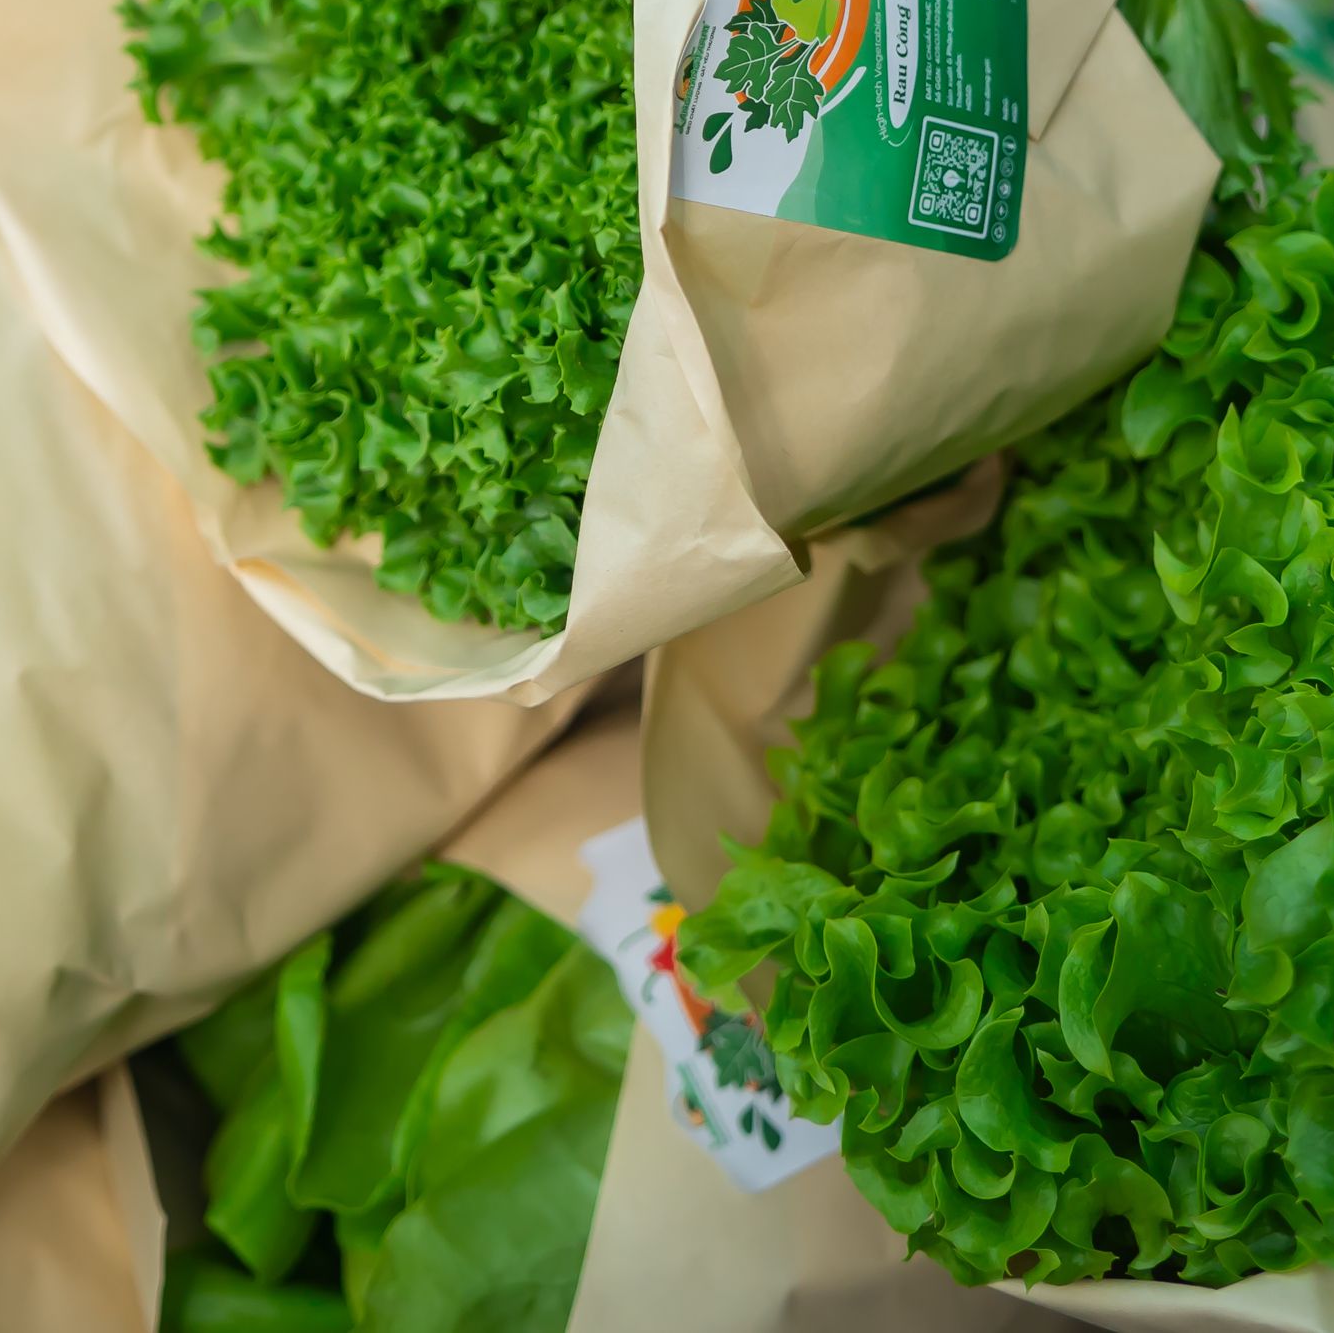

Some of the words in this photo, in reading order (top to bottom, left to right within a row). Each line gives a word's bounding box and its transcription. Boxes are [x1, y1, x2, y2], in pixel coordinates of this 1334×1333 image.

[874, 11, 884, 78] Vegetables
[895, 4, 910, 58] Công
[875, 81, 889, 141] High-tech
[893, 65, 907, 105] Rau
